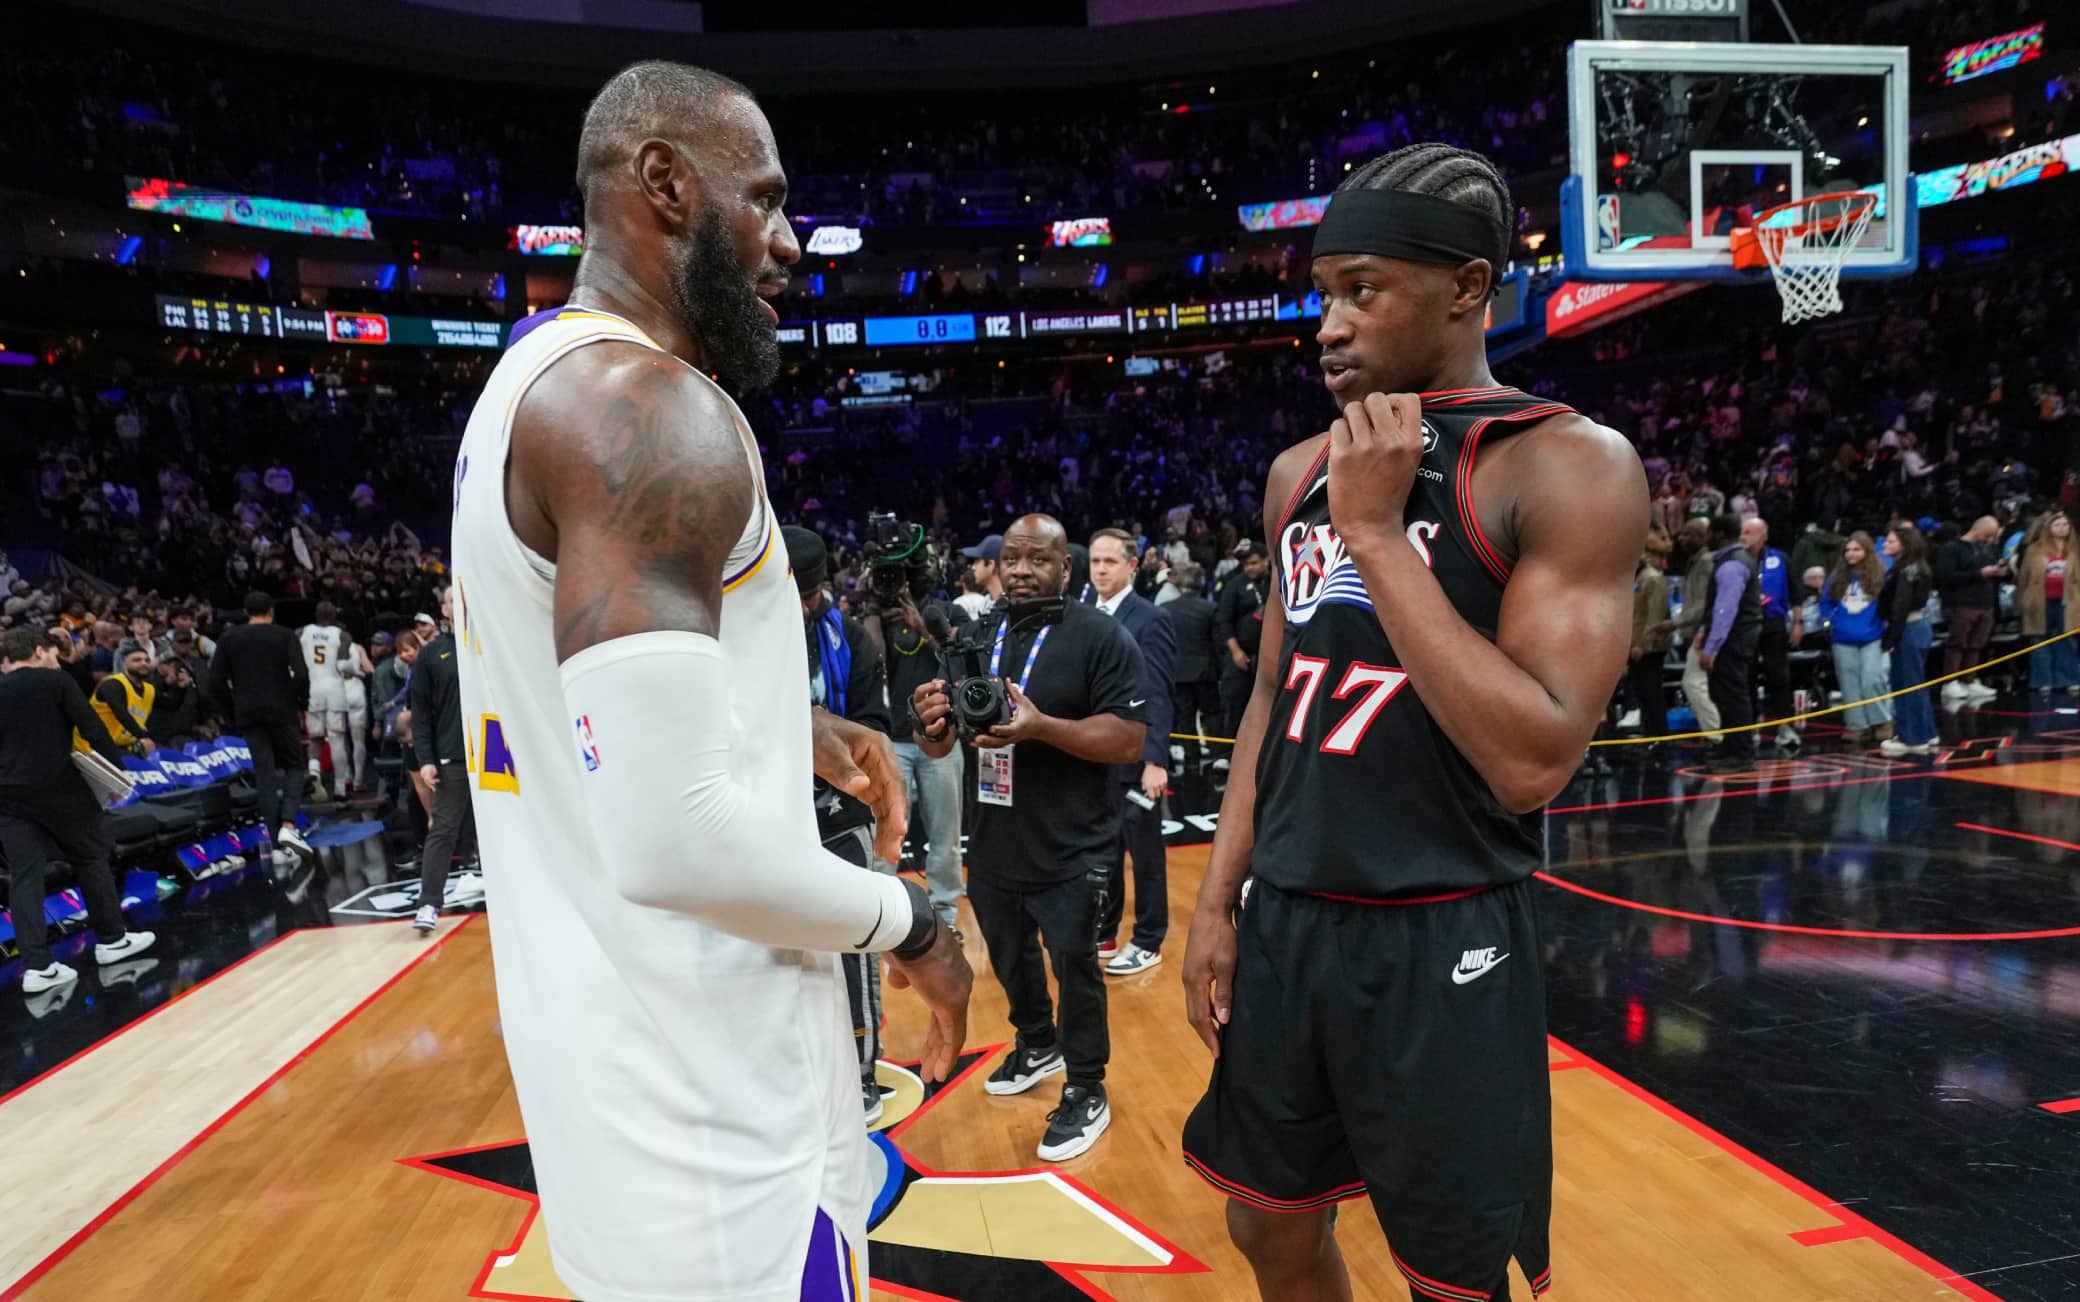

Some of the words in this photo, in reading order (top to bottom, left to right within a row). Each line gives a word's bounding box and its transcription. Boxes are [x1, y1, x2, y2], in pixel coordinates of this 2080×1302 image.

[165, 315, 187, 328] LAL
[985, 316, 1011, 337] 112
[1032, 318, 1049, 331] LOS
[1087, 314, 1122, 328] LAKERS
[825, 322, 857, 344] 108
[314, 644, 326, 666] 5
[1284, 652, 1409, 756] 77
[1459, 946, 1497, 970] NIKE
